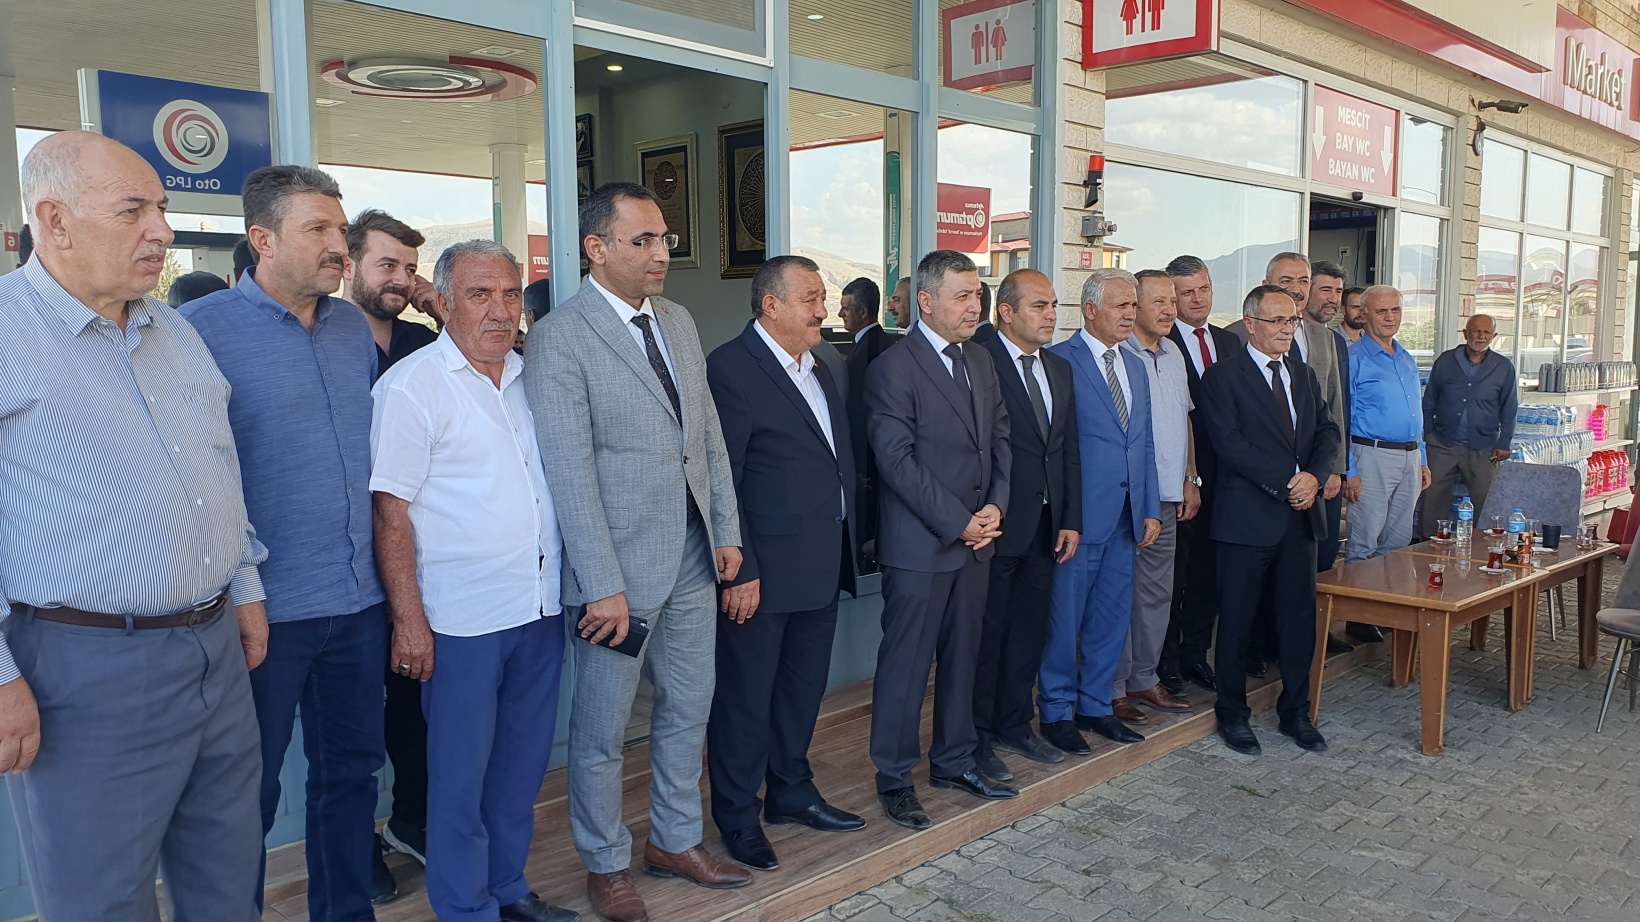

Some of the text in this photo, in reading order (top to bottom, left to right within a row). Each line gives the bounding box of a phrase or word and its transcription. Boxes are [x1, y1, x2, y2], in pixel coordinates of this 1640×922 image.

[1564, 36, 1626, 111] Market
[1338, 105, 1371, 130] MESCİT
[1335, 132, 1371, 157] BAY WC
[1328, 157, 1376, 184] BAYAN WC
